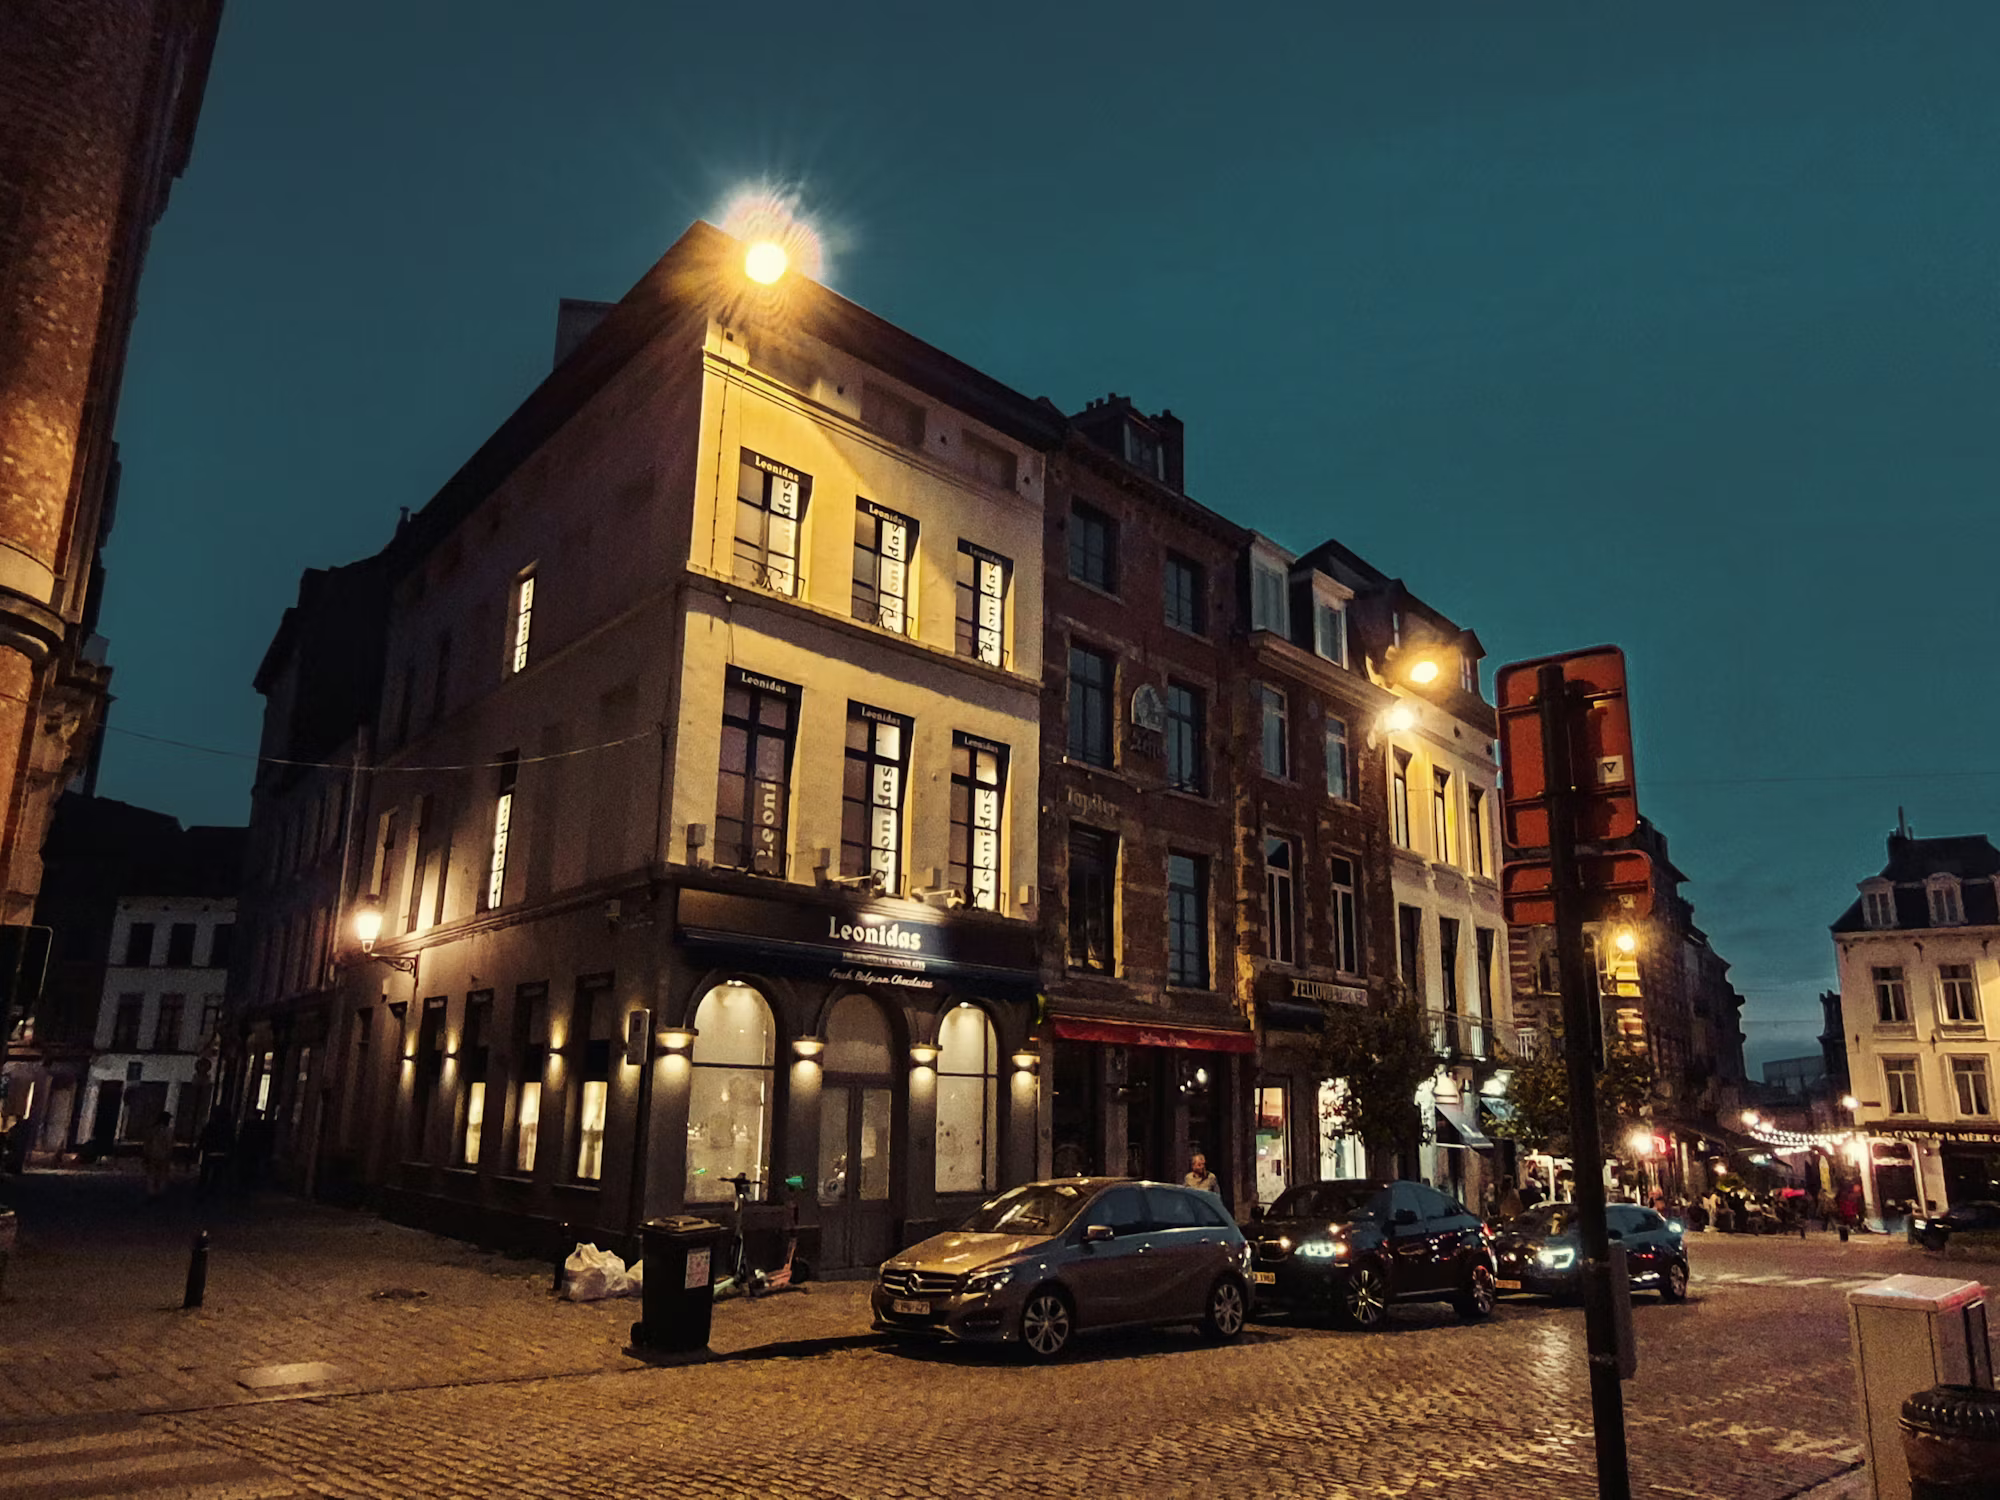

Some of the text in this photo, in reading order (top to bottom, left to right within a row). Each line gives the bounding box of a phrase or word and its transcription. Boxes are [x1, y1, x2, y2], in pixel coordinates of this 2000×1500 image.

[755, 455, 799, 482] Leonidas
[869, 503, 906, 526] Leonidas
[741, 671, 787, 694] Leonidas
[861, 706, 901, 726] Leonidas
[964, 735, 999, 754] Leonidas
[828, 915, 922, 951] Leonidas
[890, 974, 933, 989] Chocolates
[1894, 1130, 1930, 1139] CAVES
[1931, 1131, 1944, 1140] de
[1946, 1132, 1956, 1141] la
